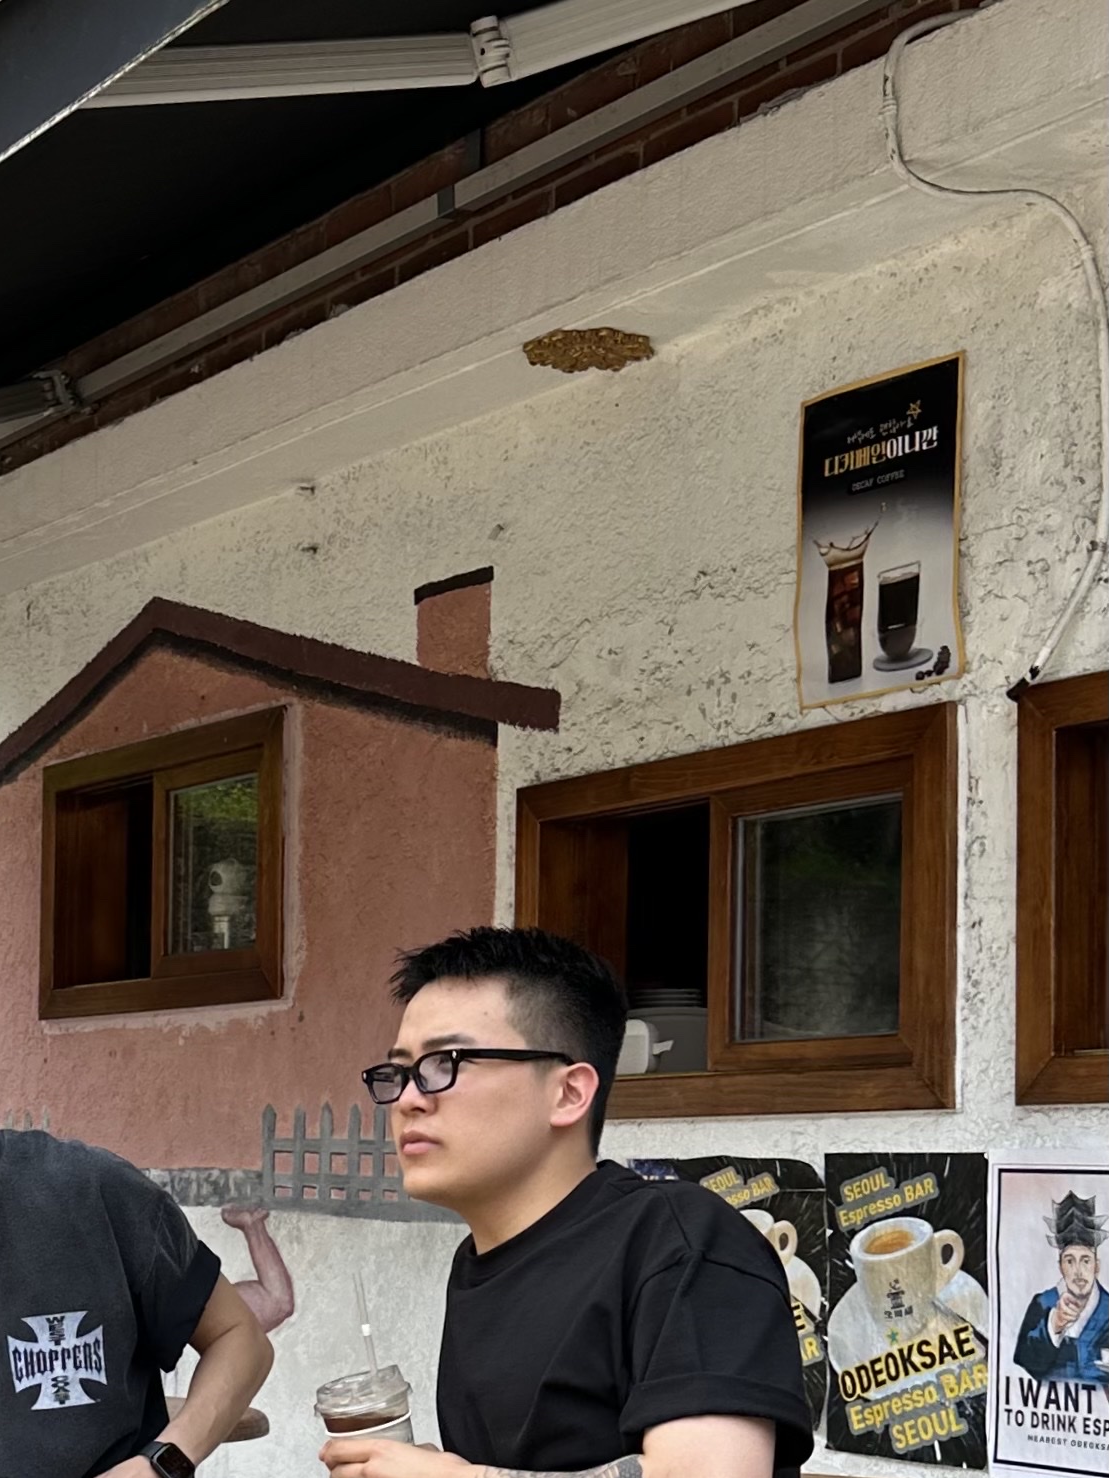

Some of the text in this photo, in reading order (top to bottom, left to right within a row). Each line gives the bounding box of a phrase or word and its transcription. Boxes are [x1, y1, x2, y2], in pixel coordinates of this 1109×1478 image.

[751, 1176, 775, 1197] BAR
[838, 1178, 934, 1227] Espresso BAR
[843, 1172, 891, 1202] SEOUL
[12, 1338, 102, 1384] CHOPPERS
[840, 1325, 976, 1400] ODEOKSAE
[850, 1364, 987, 1430] Espresso BAR
[1005, 1376, 1097, 1415] I WANT
[893, 1408, 963, 1449] SEOUL
[1004, 1408, 1025, 1427] TO
[1031, 1411, 1077, 1434] DRINK
